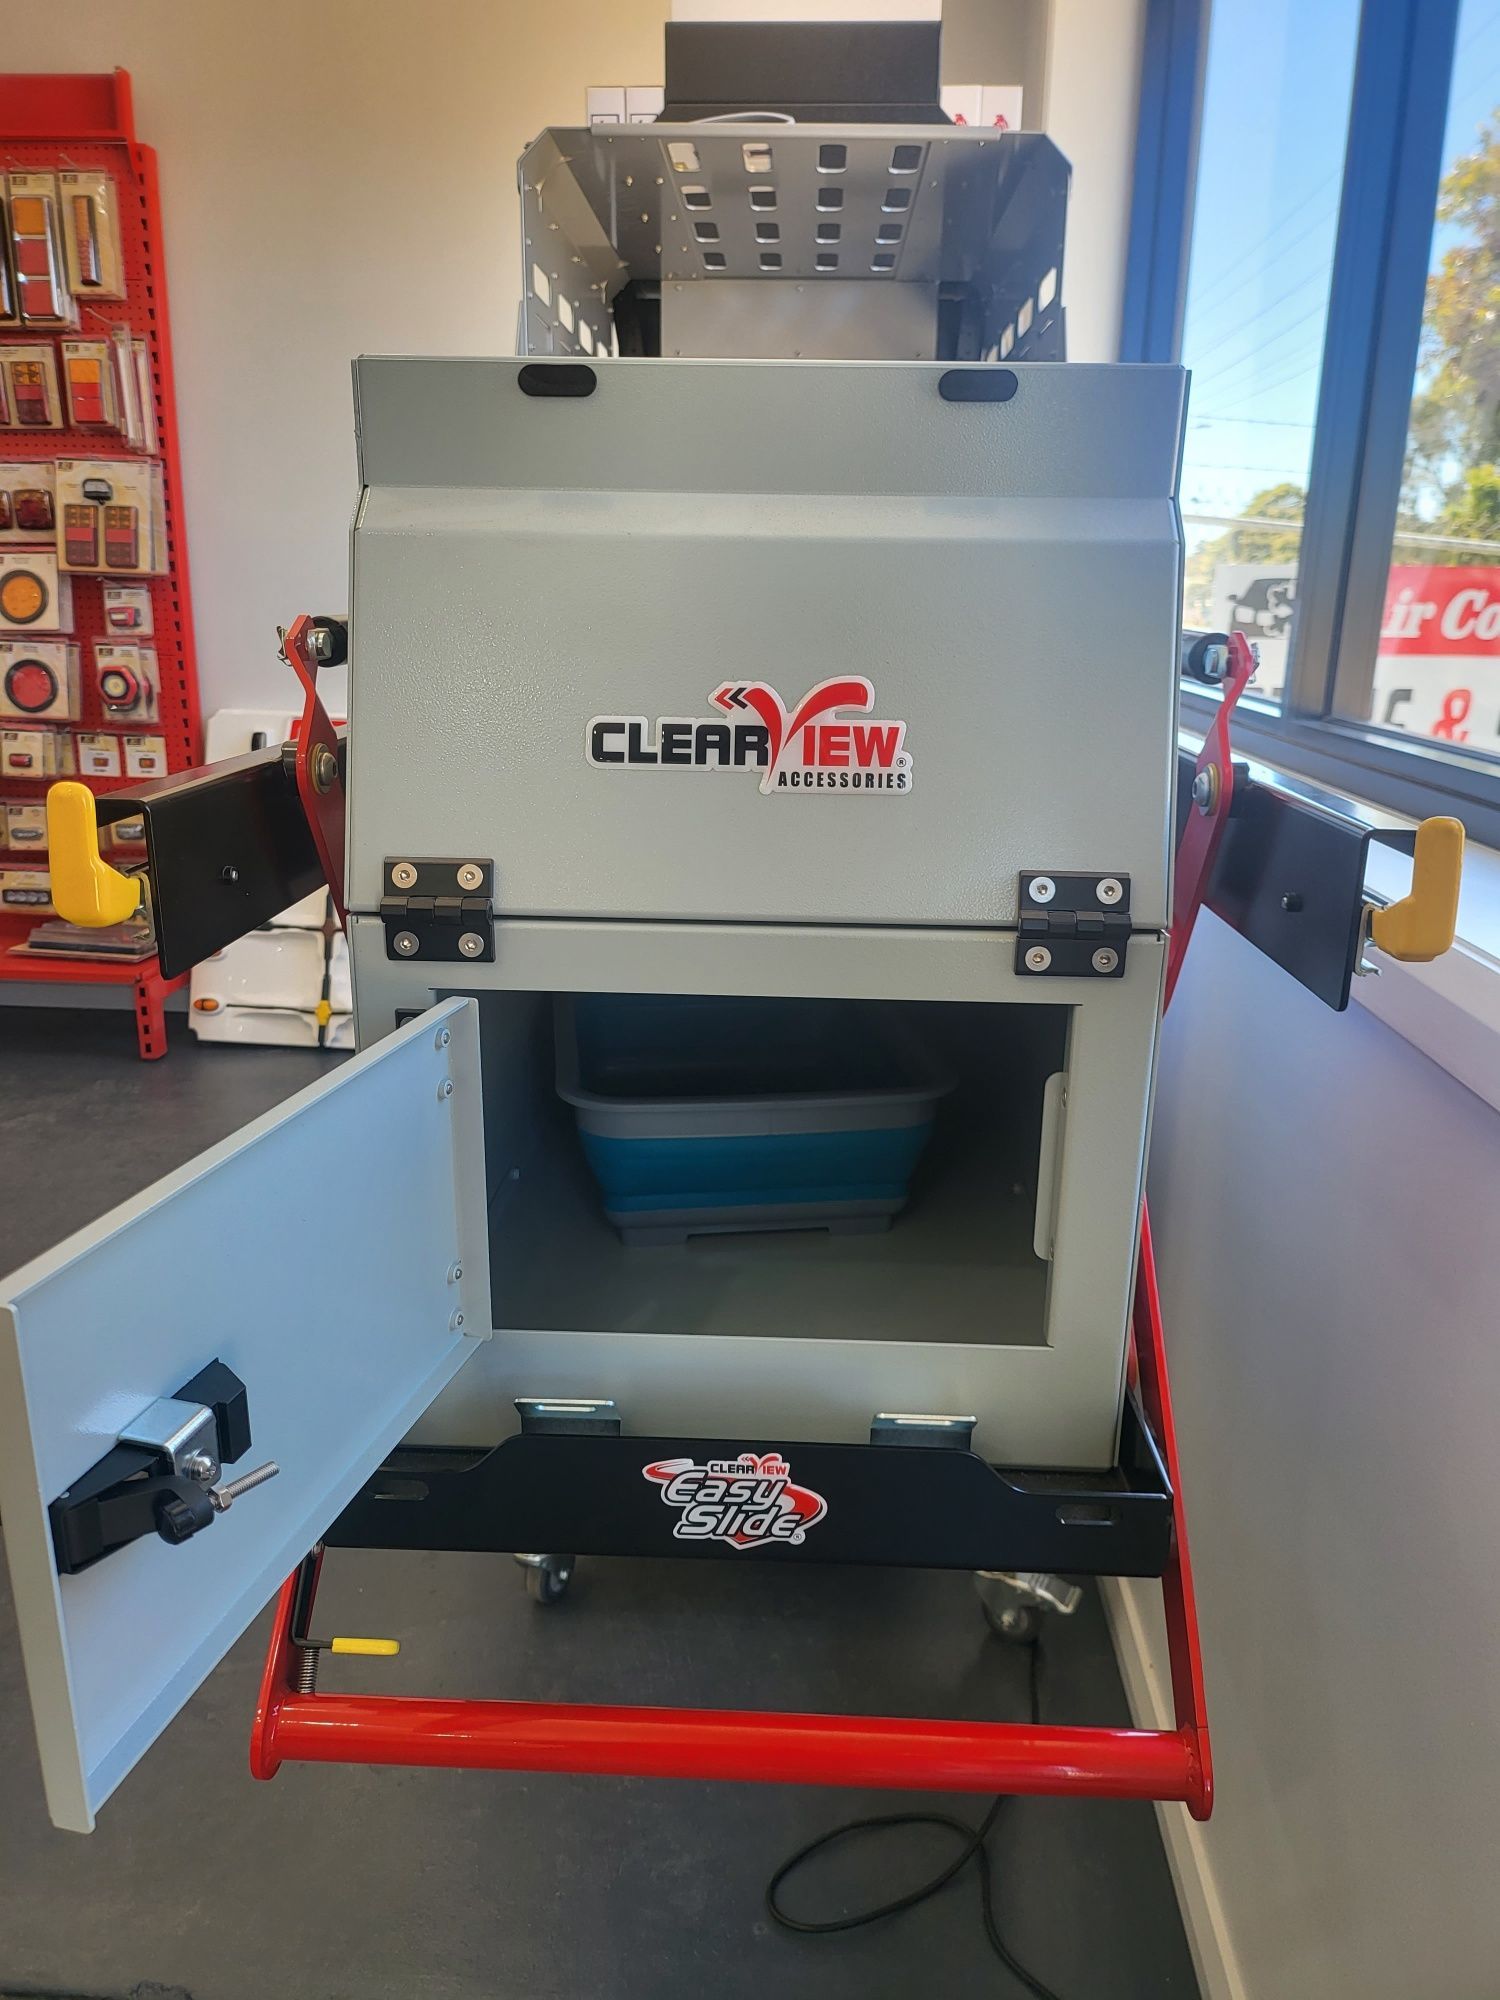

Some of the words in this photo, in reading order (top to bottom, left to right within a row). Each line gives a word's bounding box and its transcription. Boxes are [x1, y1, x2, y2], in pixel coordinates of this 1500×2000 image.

[591, 683, 902, 775] CLEARVIEW
[777, 771, 907, 790] ACCESSORIES
[709, 1457, 788, 1476] CLEARVIEW
[666, 1471, 787, 1511] Easy
[679, 1505, 804, 1537] Slide
